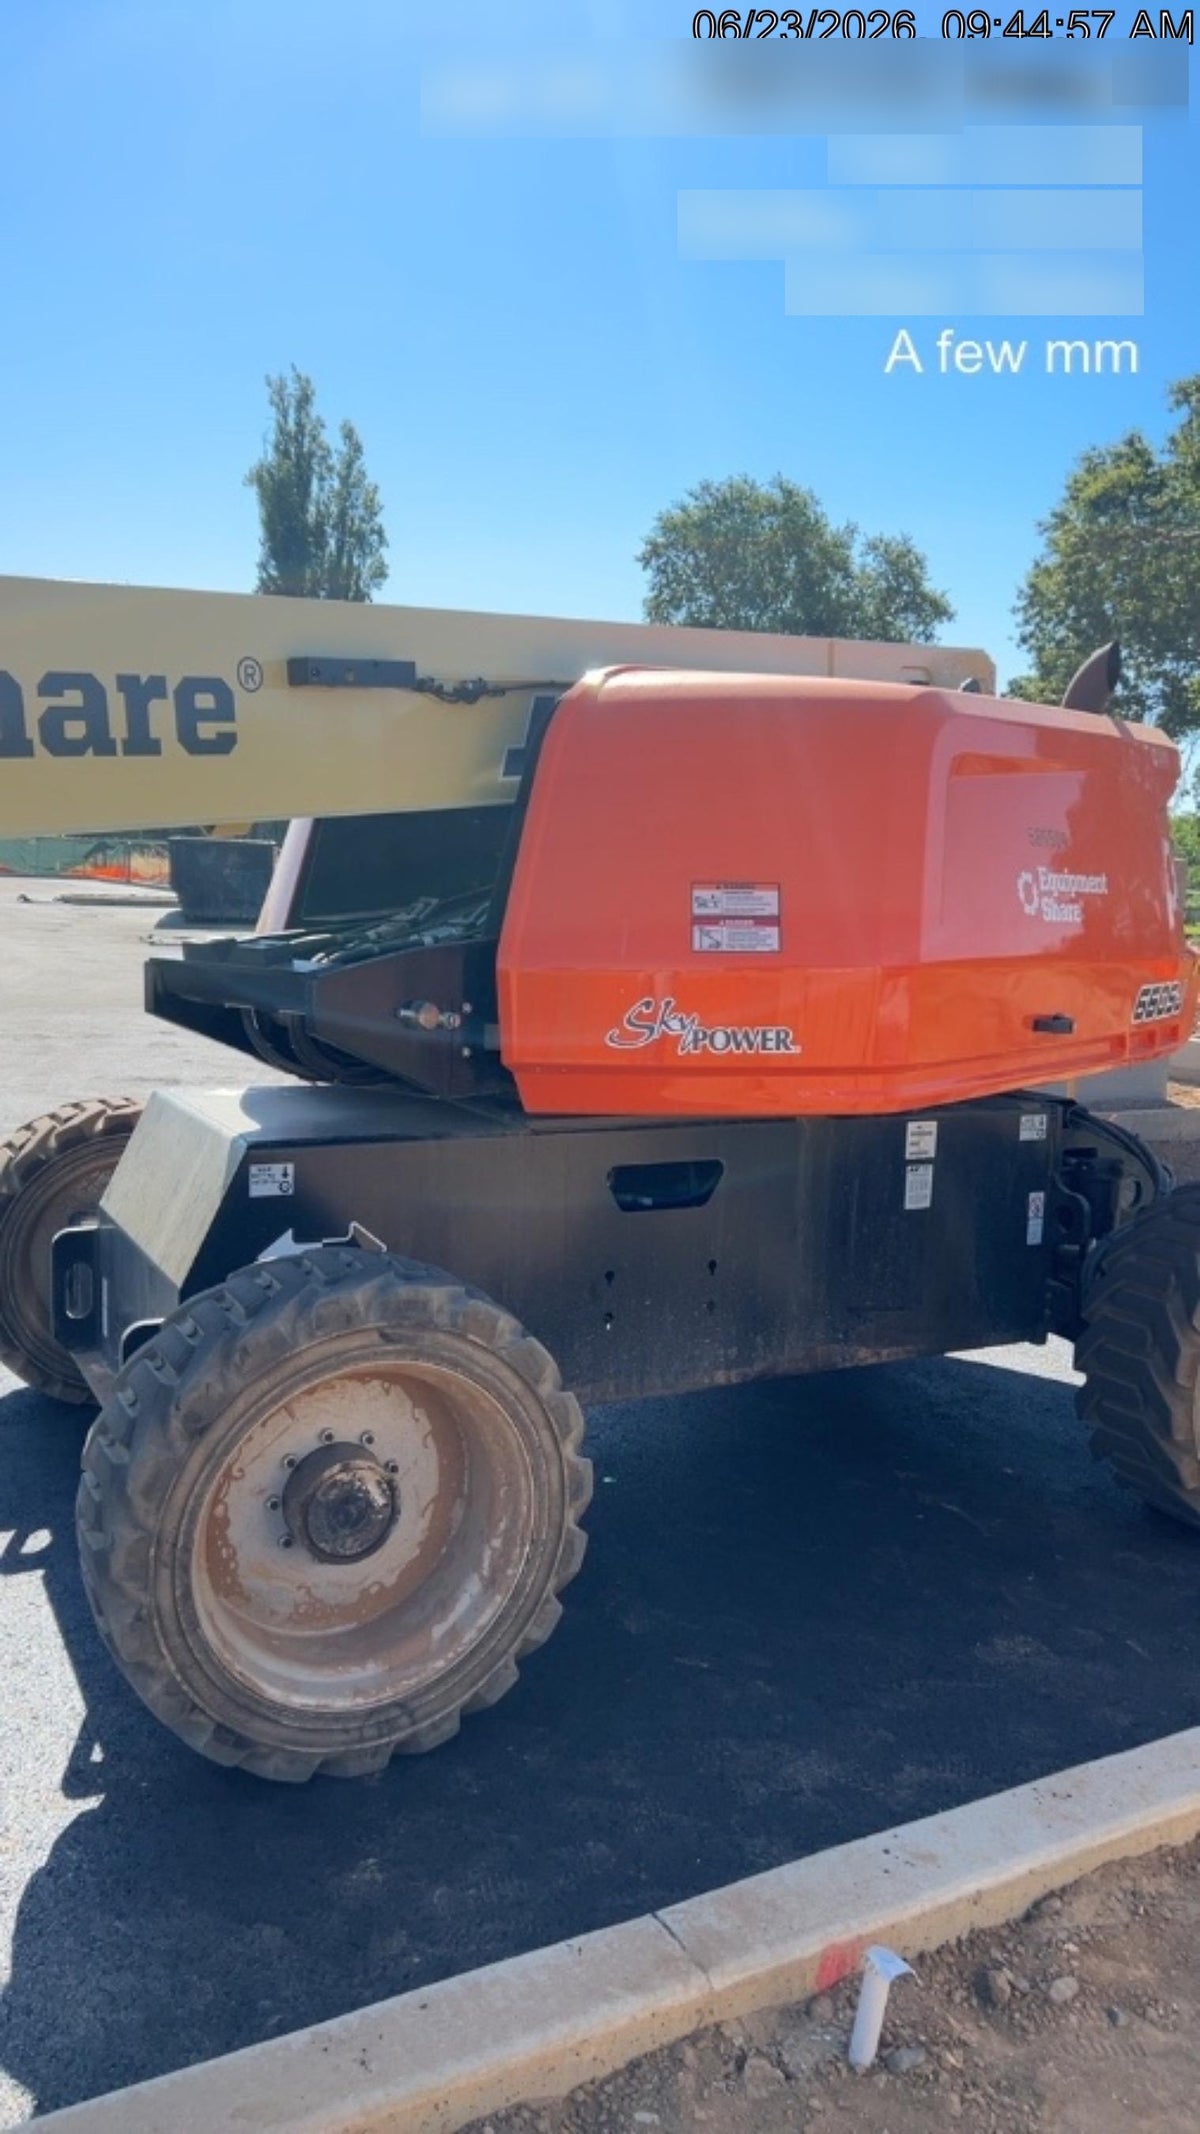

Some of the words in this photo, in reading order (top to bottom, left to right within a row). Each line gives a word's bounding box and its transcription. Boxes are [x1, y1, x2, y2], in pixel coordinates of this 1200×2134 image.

[1036, 866, 1108, 898] Equipment
[1040, 898, 1084, 923] Share
[690, 1026, 796, 1053] POWER
